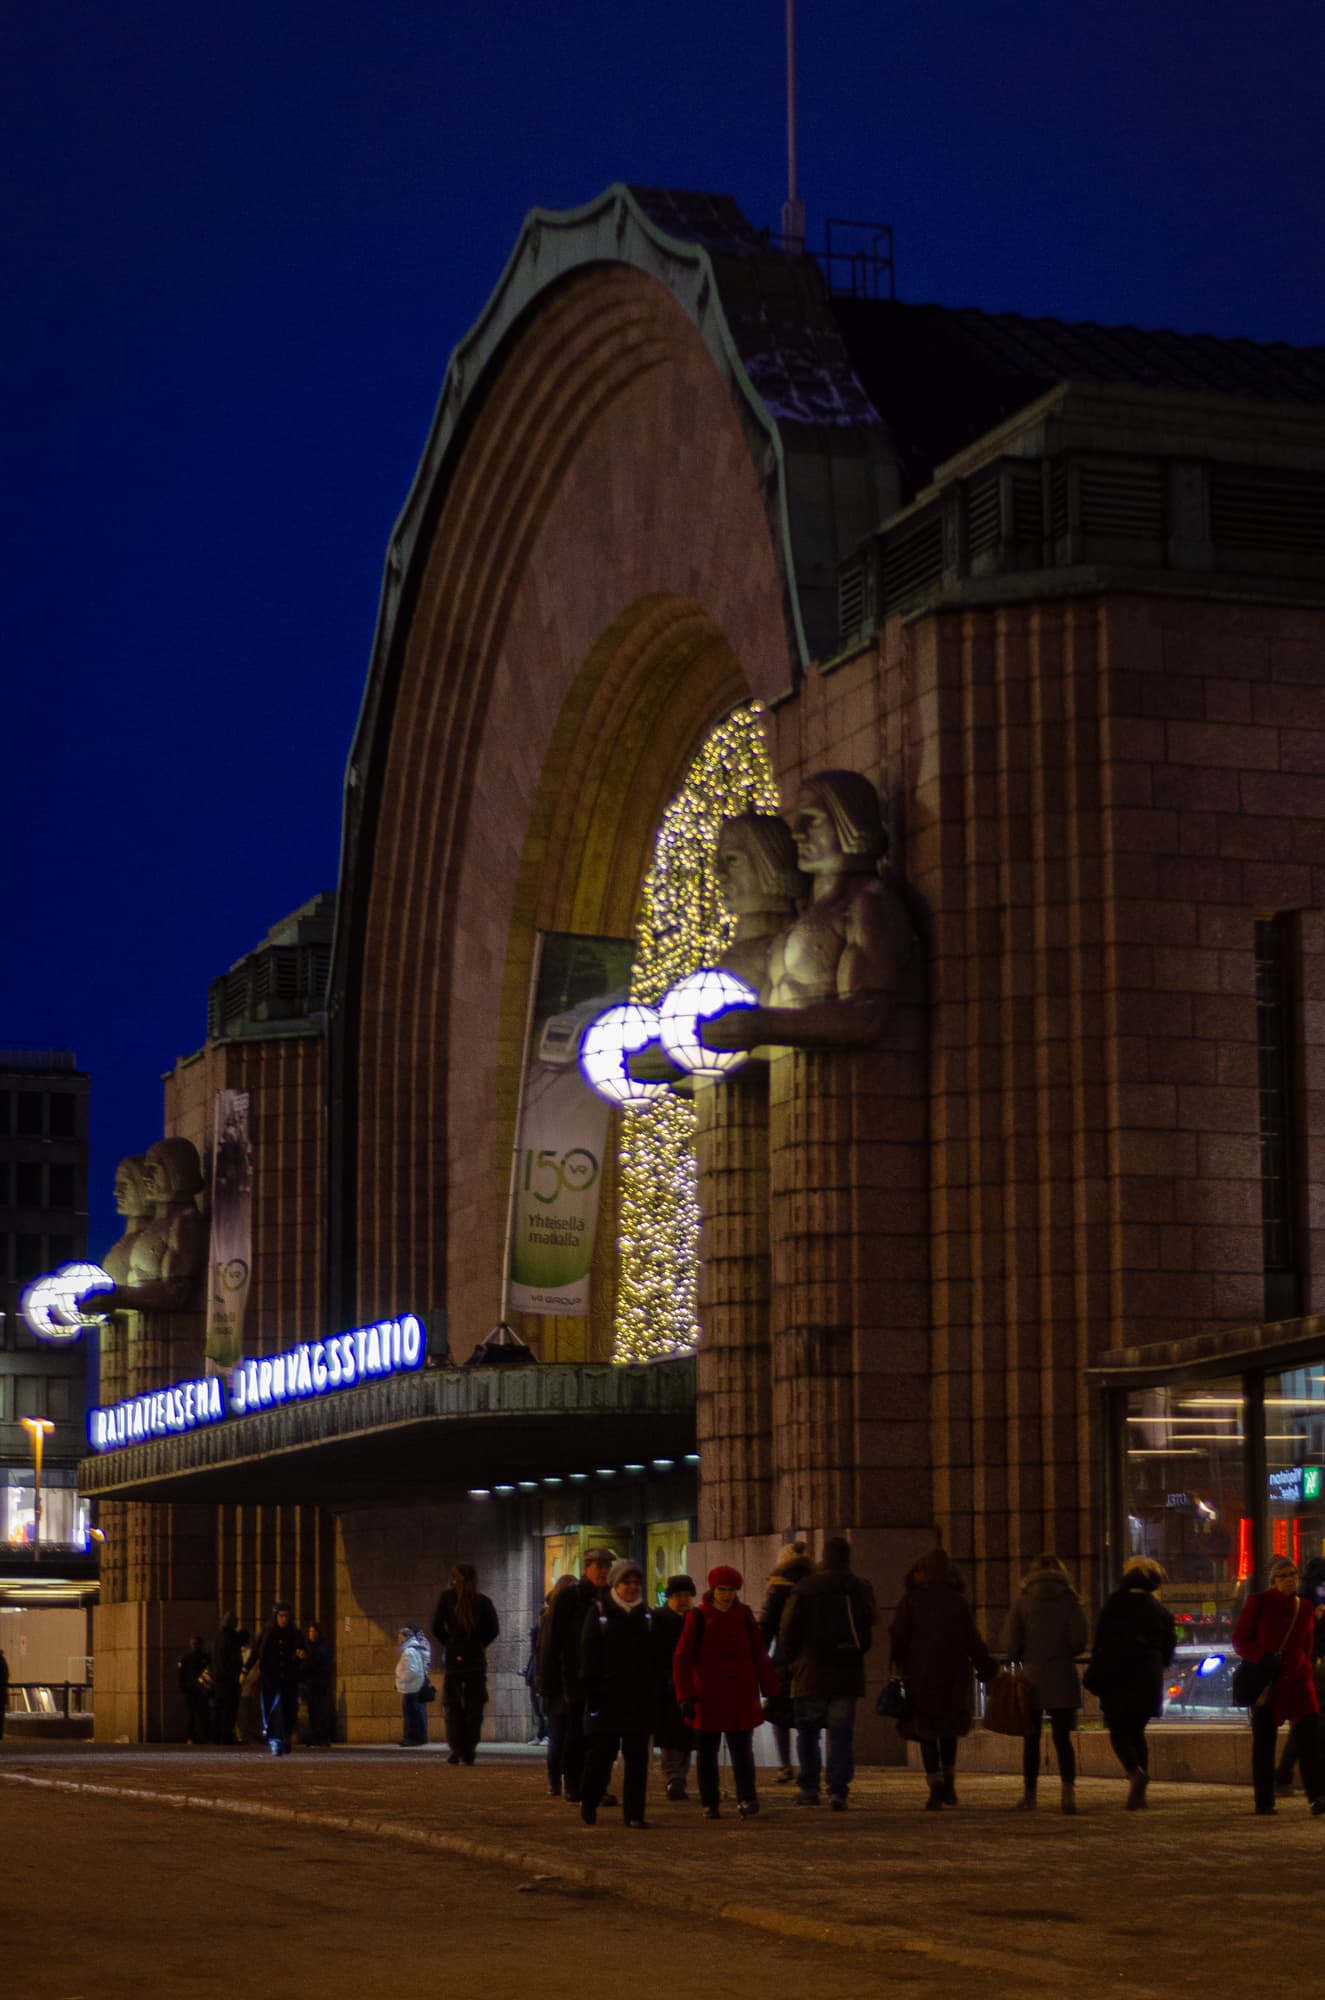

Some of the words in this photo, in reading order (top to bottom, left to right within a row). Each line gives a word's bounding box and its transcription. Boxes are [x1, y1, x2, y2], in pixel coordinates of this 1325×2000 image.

[524, 1148, 598, 1204] 150
[569, 1164, 587, 1176] VR
[92, 1377, 223, 1448] RAUTATIEASEMA
